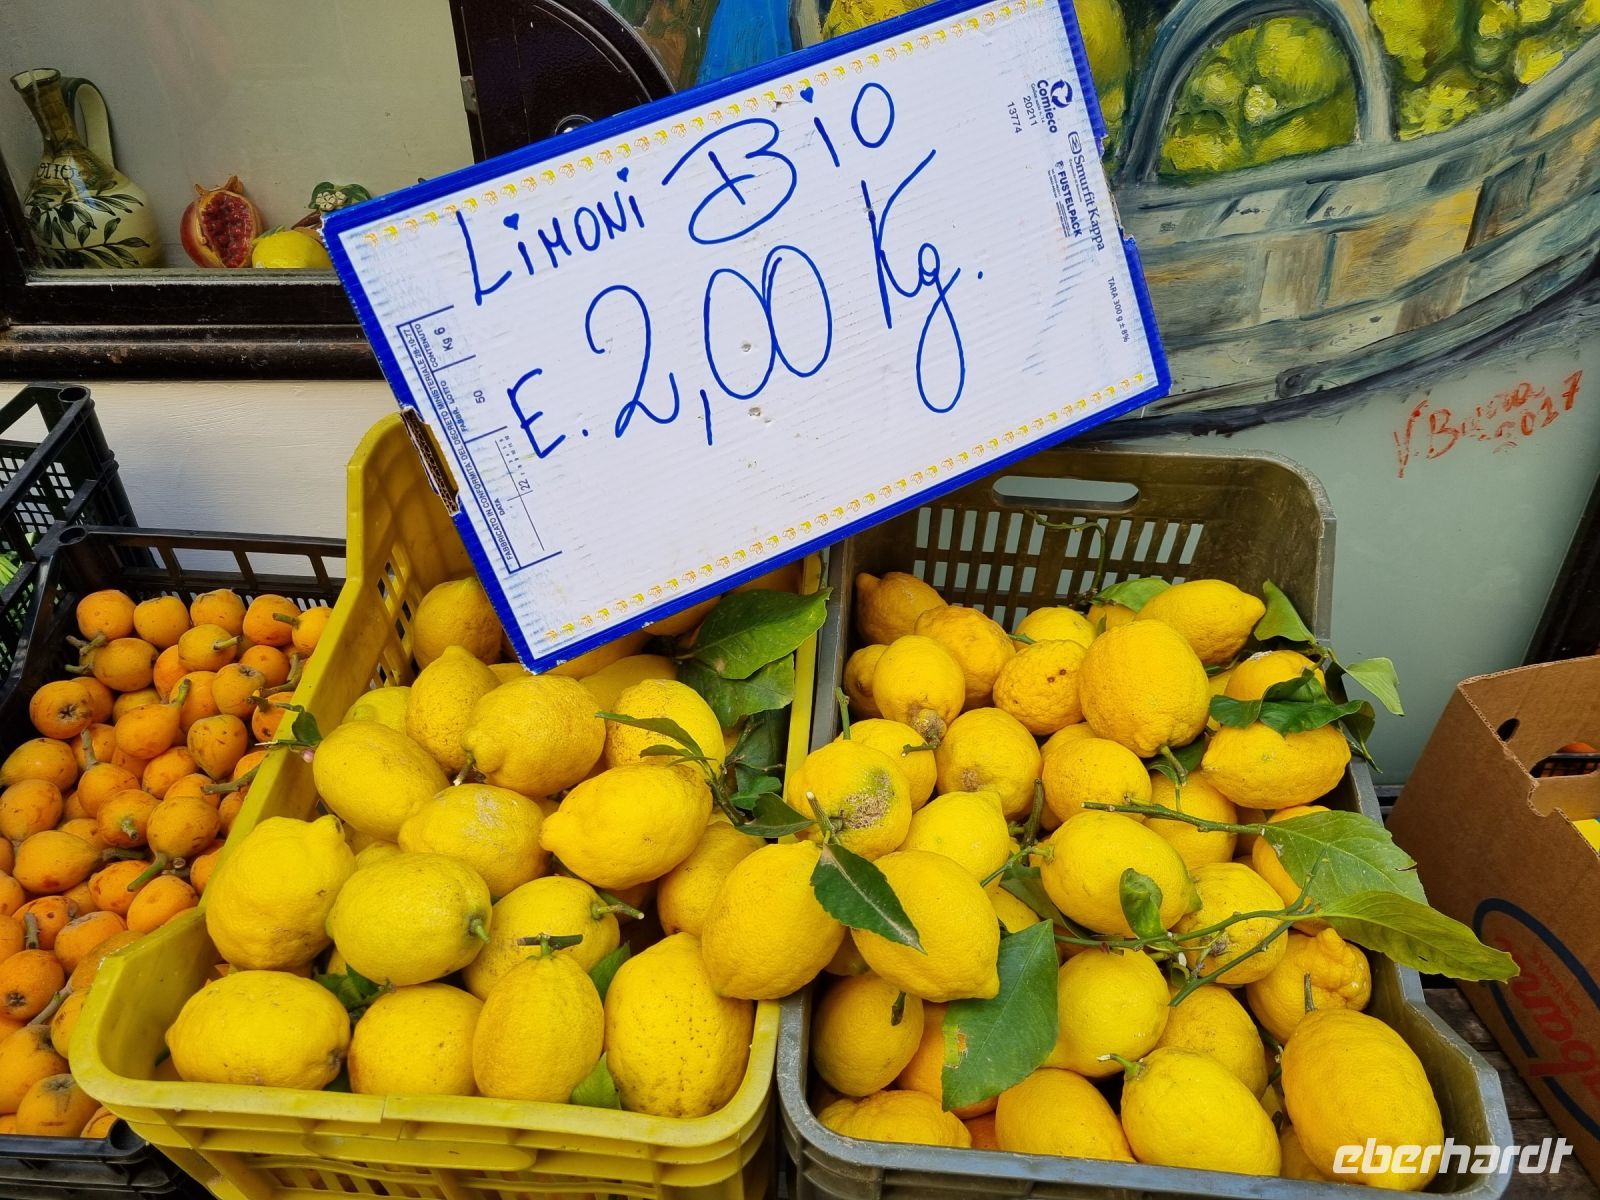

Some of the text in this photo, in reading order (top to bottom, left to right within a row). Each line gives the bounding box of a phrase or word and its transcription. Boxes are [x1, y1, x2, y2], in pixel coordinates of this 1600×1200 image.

[1007, 101, 1022, 134] 13774
[1023, 96, 1038, 126] 20211
[1037, 79, 1057, 133] Comieco
[1058, 171, 1083, 237] FUSTELPACK
[1073, 155, 1095, 211] Smurfit
[1088, 204, 1105, 251] Kappa
[1107, 276, 1118, 298] TARA
[1111, 299, 1122, 315] 300
[415, 323, 438, 368] CONTENUTO
[433, 325, 454, 352] Kg 6
[417, 358, 445, 411] MINISTERIALE
[440, 380, 455, 404] LOTTO
[472, 388, 486, 404] 50
[442, 411, 461, 445] DECRETO
[458, 445, 468, 460] DEL
[517, 477, 531, 491] 22
[494, 498, 505, 516] DATA
[490, 517, 512, 560] FABBRICATO
